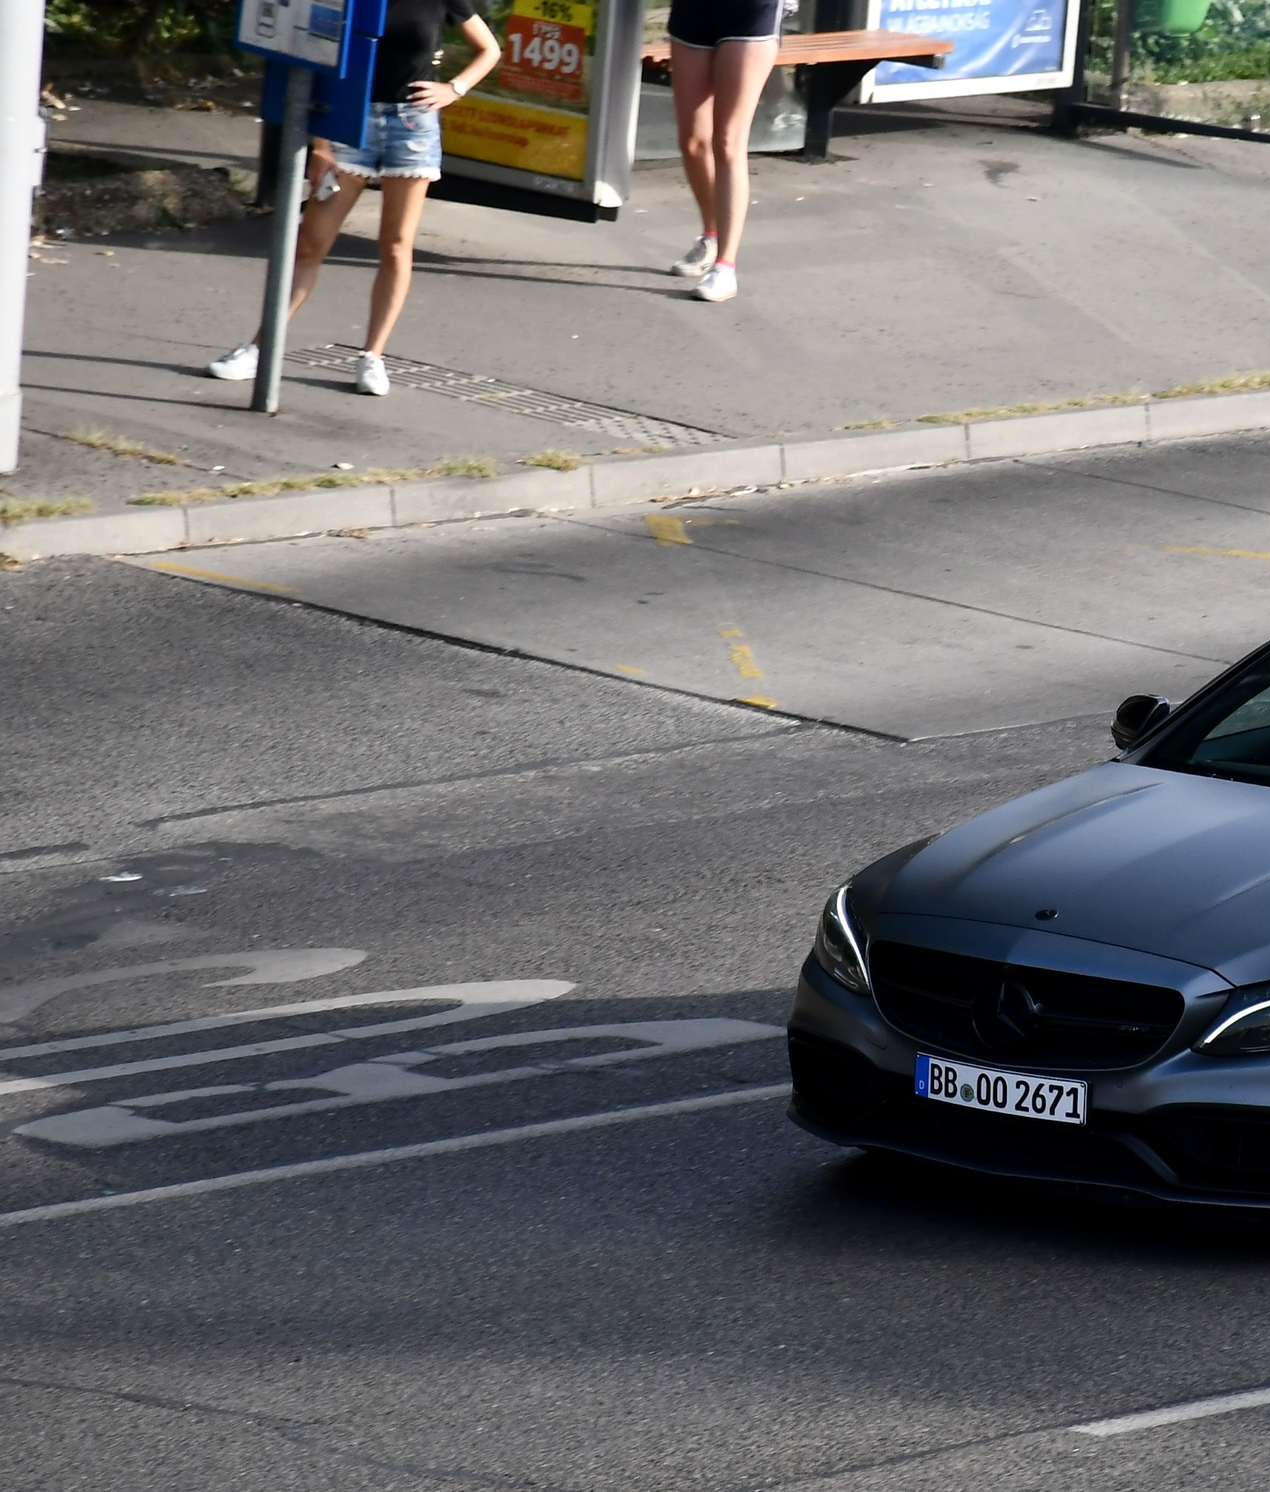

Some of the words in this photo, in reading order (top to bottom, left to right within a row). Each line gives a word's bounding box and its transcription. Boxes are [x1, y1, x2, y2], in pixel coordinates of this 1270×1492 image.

[508, 32, 579, 74] 1499
[918, 1080, 925, 1090] D
[930, 1063, 957, 1098] BB
[1014, 1080, 1080, 1119] 2671
